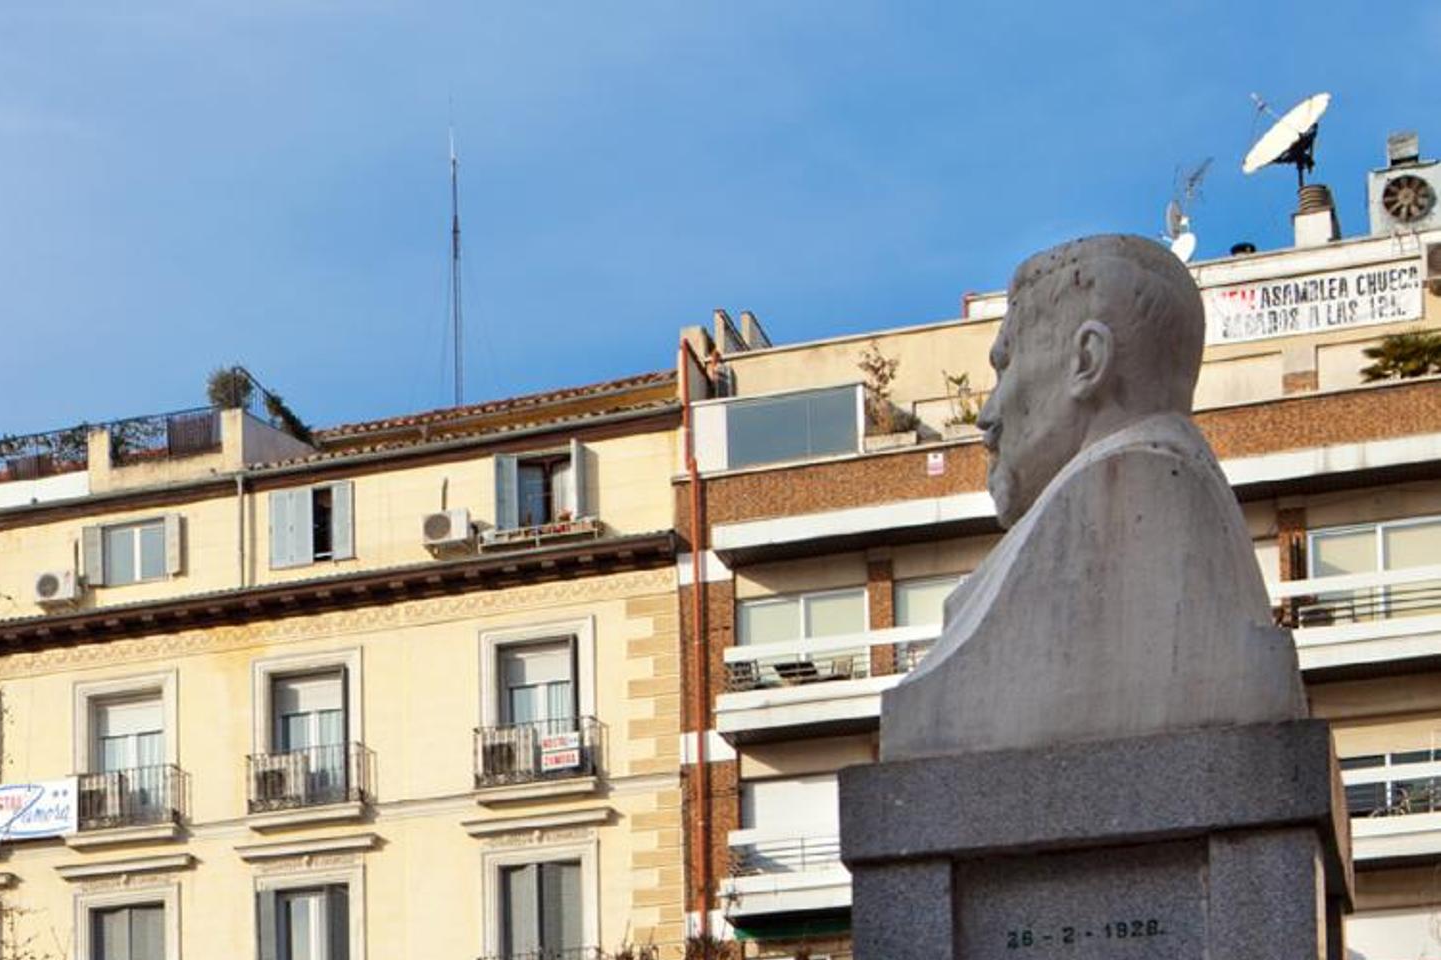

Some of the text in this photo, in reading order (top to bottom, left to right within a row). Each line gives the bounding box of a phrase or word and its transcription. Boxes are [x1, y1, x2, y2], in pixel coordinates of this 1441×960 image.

[1261, 277, 1349, 309] ASAMBLEA
[1356, 266, 1419, 296] CHUECA
[1327, 299, 1358, 326] LAS
